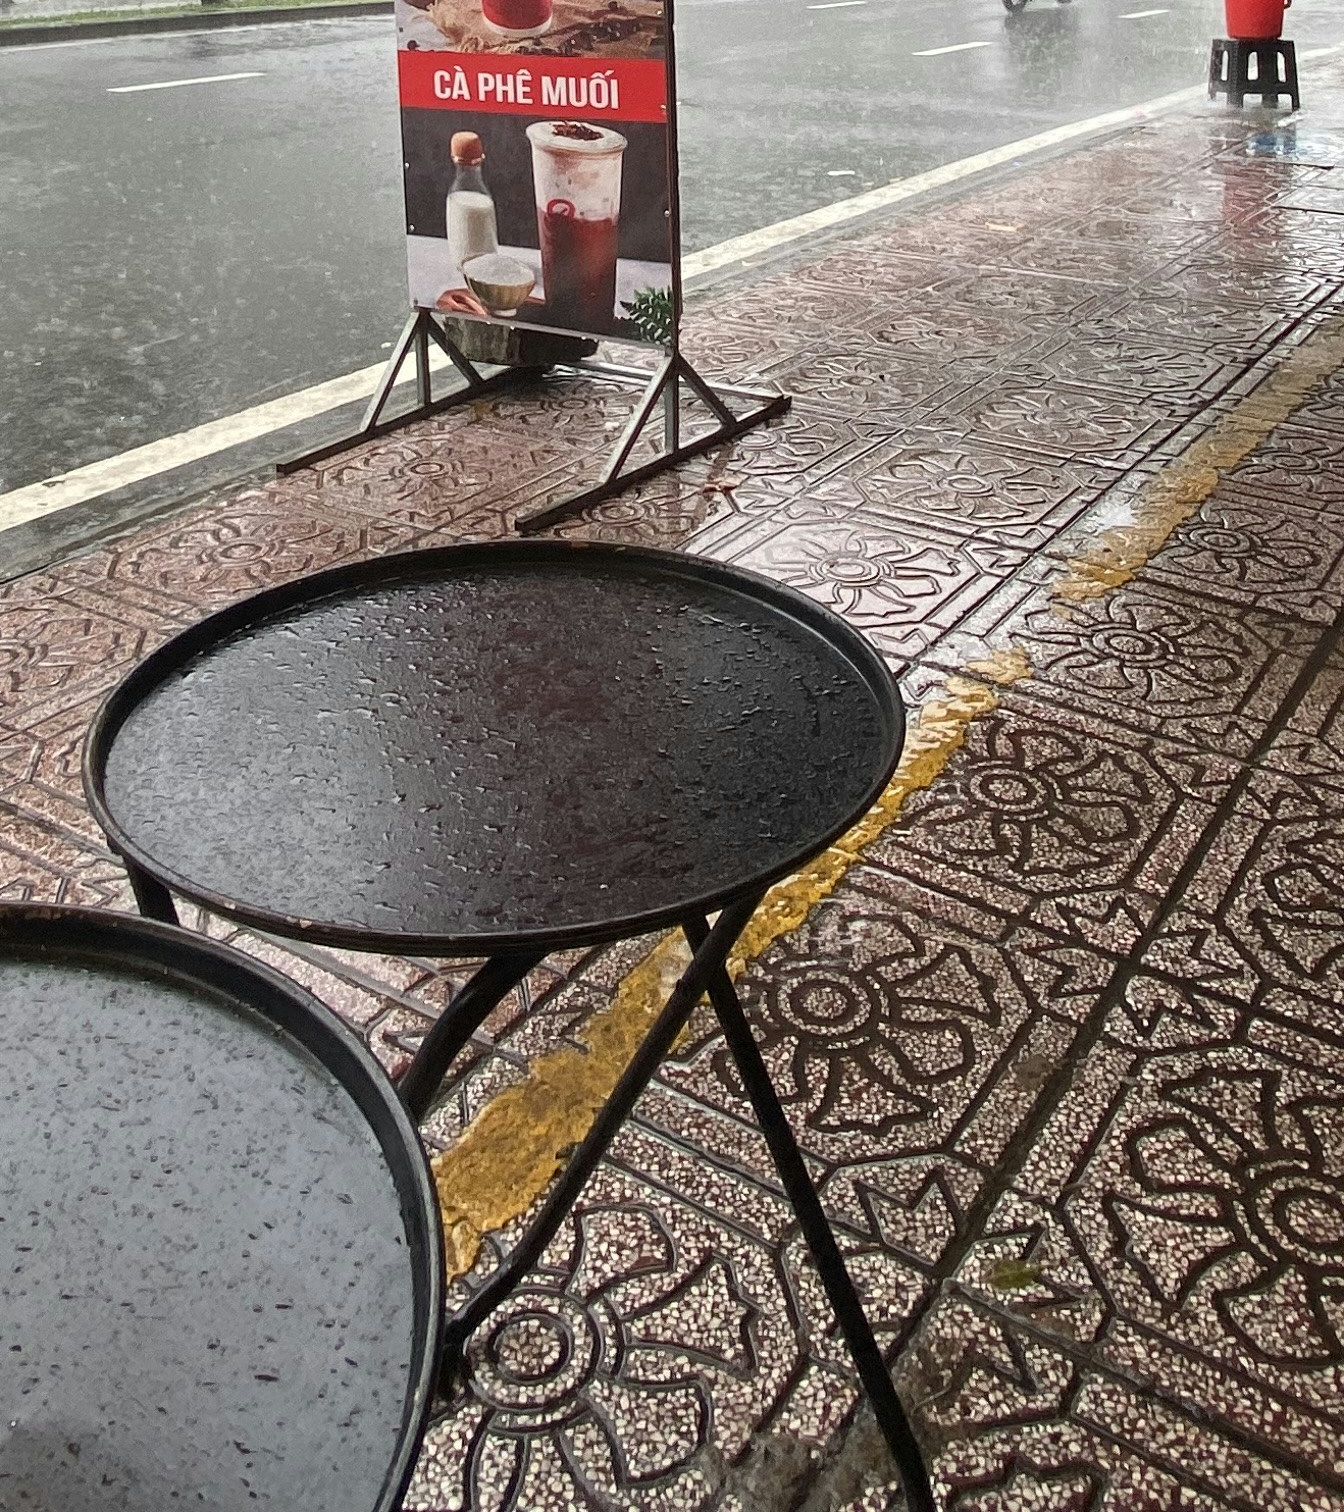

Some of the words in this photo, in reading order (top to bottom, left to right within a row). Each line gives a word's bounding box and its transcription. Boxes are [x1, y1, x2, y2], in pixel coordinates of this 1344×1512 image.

[433, 64, 471, 102] CÀ
[478, 66, 534, 106] PHÊ
[541, 69, 620, 111] MUỐI
